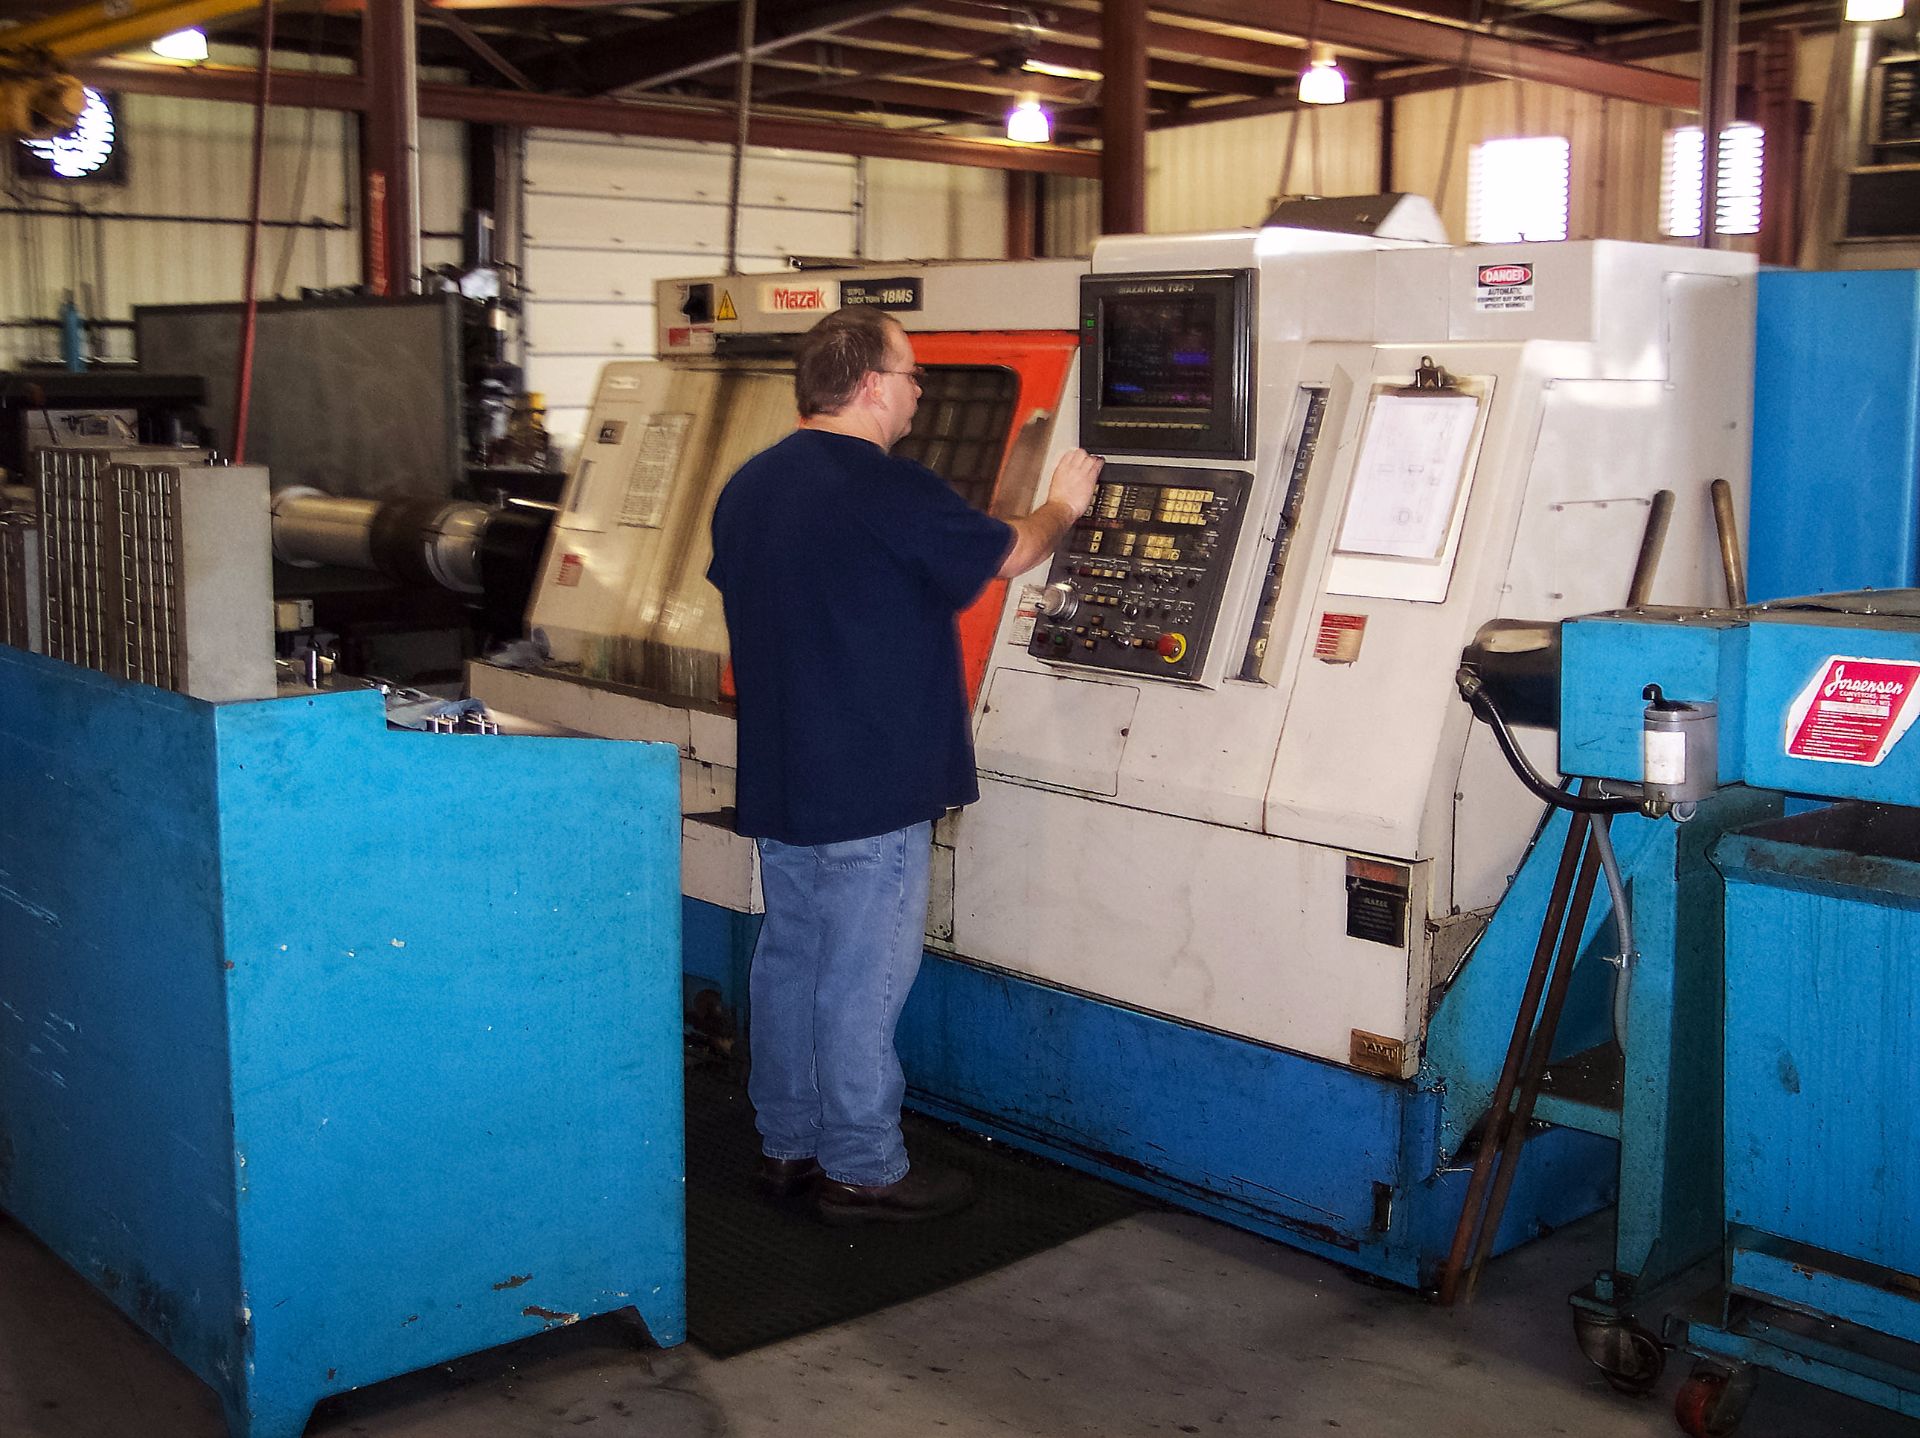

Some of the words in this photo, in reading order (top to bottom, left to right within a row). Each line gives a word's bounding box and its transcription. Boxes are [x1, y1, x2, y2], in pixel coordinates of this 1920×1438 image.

[1486, 269, 1525, 282] DANGER
[774, 288, 827, 310] Mazak
[882, 289, 914, 304] 18MS
[1488, 287, 1523, 296] AUTOMATIC
[1823, 664, 1904, 697] Jorgensen
